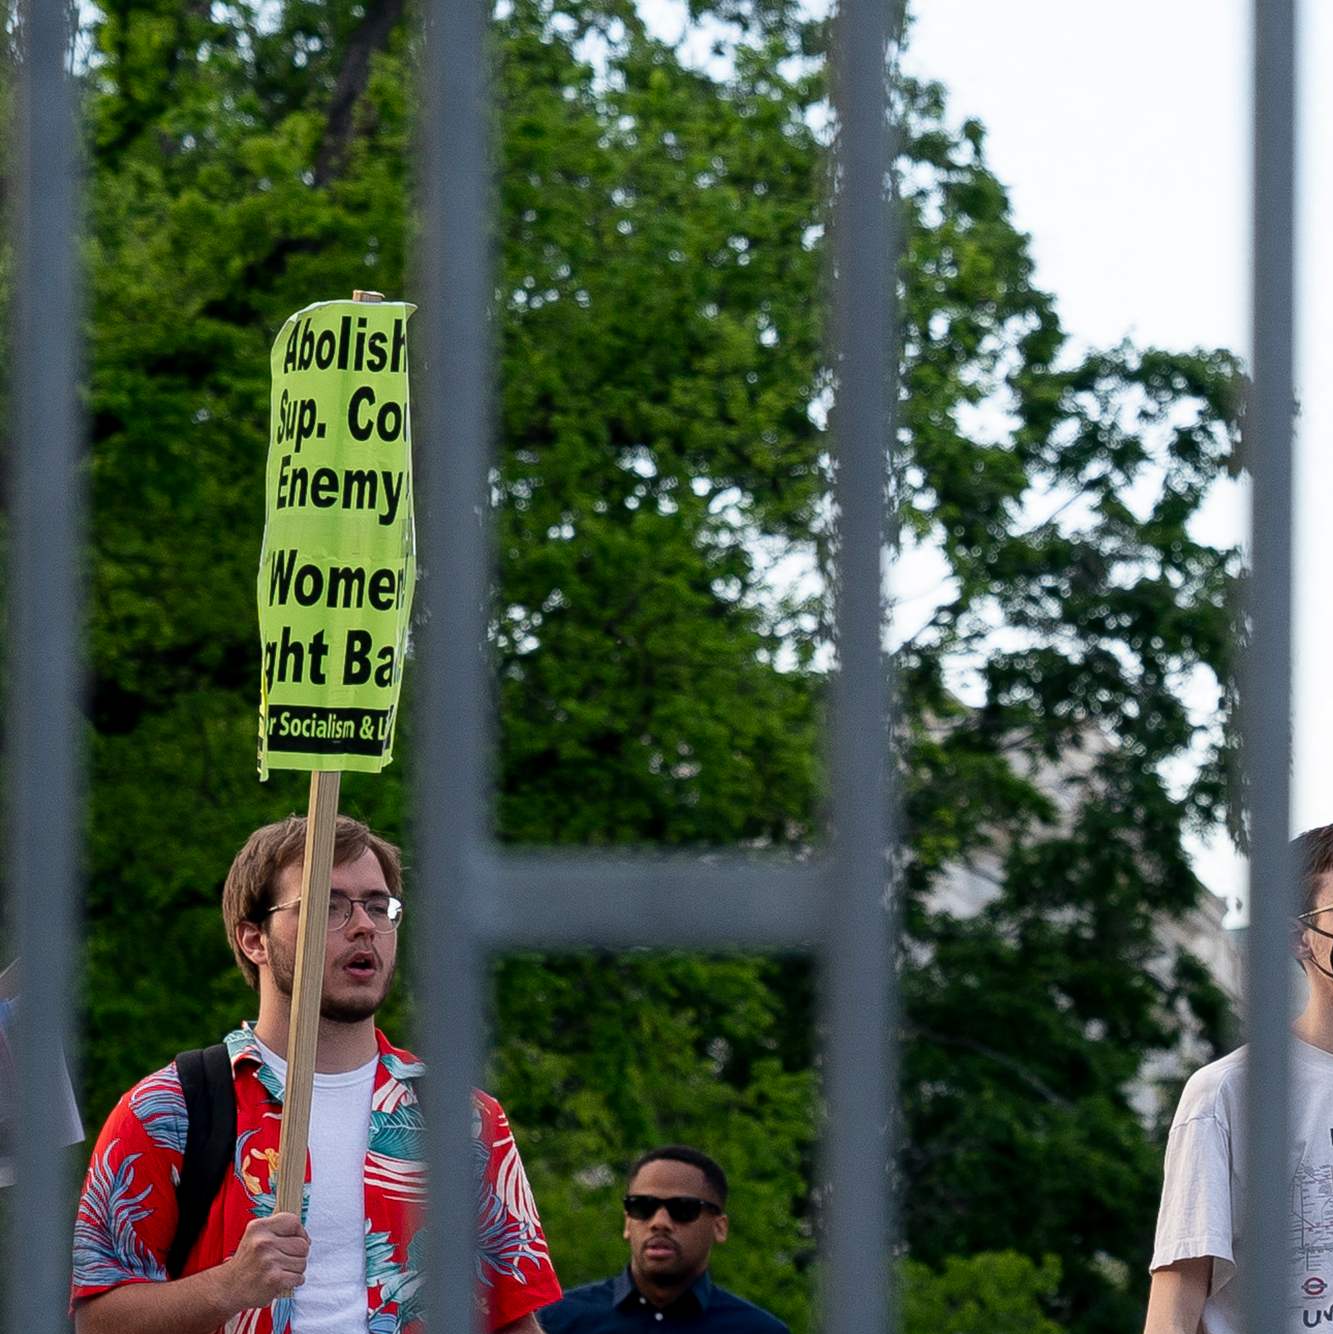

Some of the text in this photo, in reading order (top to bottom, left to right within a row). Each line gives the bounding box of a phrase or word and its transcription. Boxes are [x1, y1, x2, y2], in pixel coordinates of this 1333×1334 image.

[277, 385, 407, 453] Sup. Co
[276, 455, 403, 526] Enemy
[279, 711, 355, 739] Socialism
[359, 715, 375, 740] &
